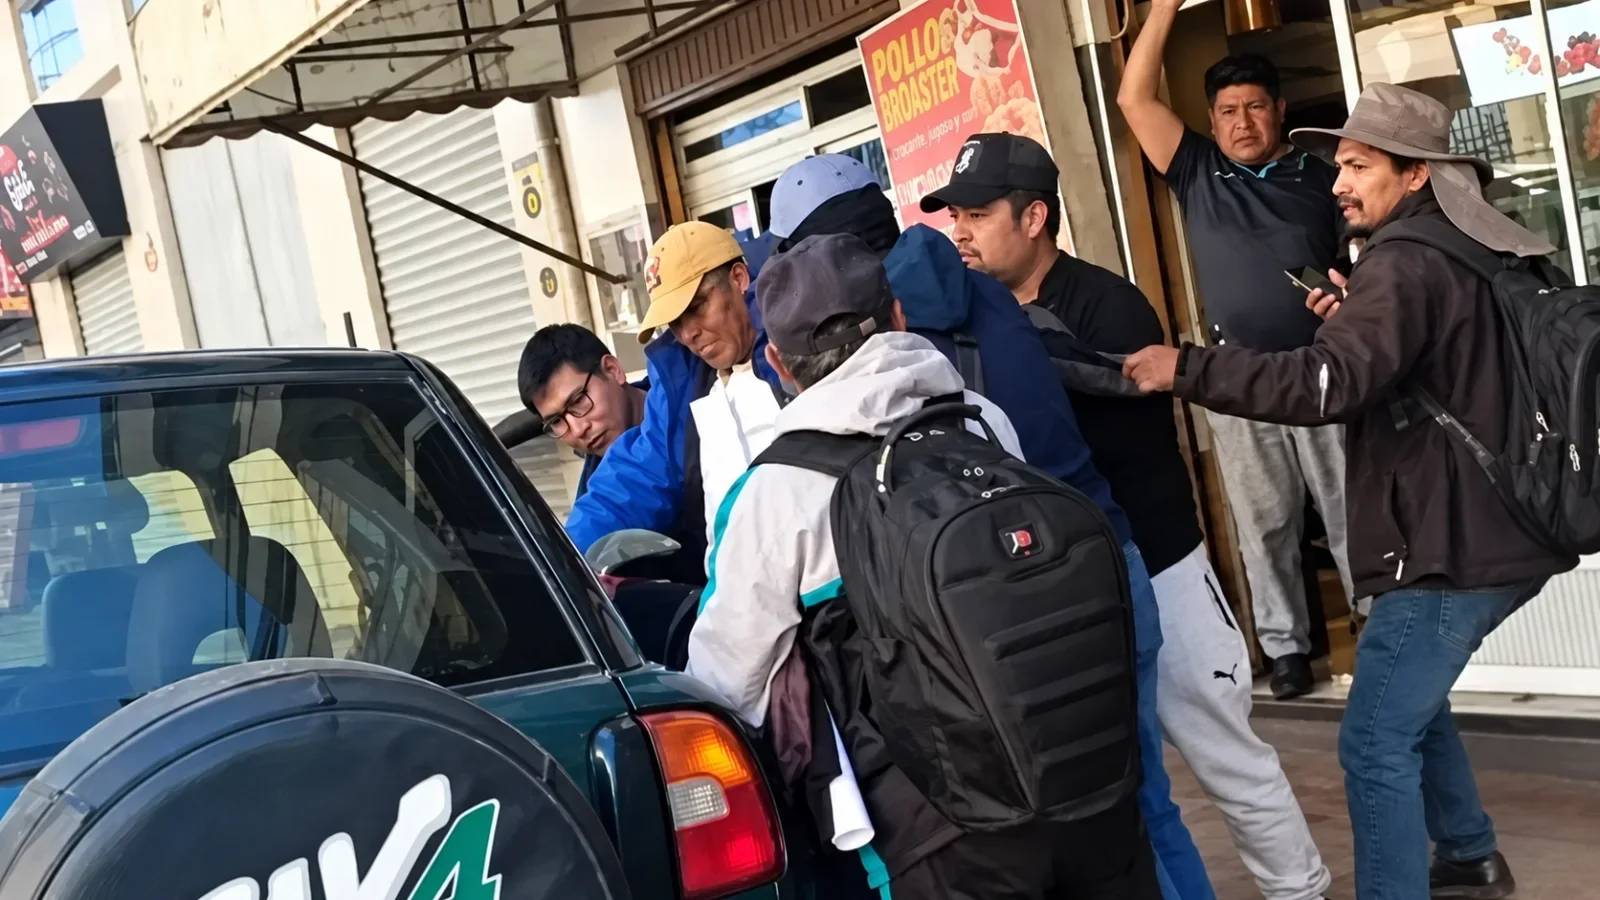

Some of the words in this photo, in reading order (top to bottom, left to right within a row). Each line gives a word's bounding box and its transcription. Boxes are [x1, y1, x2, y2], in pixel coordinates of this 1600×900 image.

[872, 17, 940, 94] POLLO
[879, 56, 961, 133] BROASTER
[954, 114, 961, 133] y
[195, 773, 503, 900] V4
